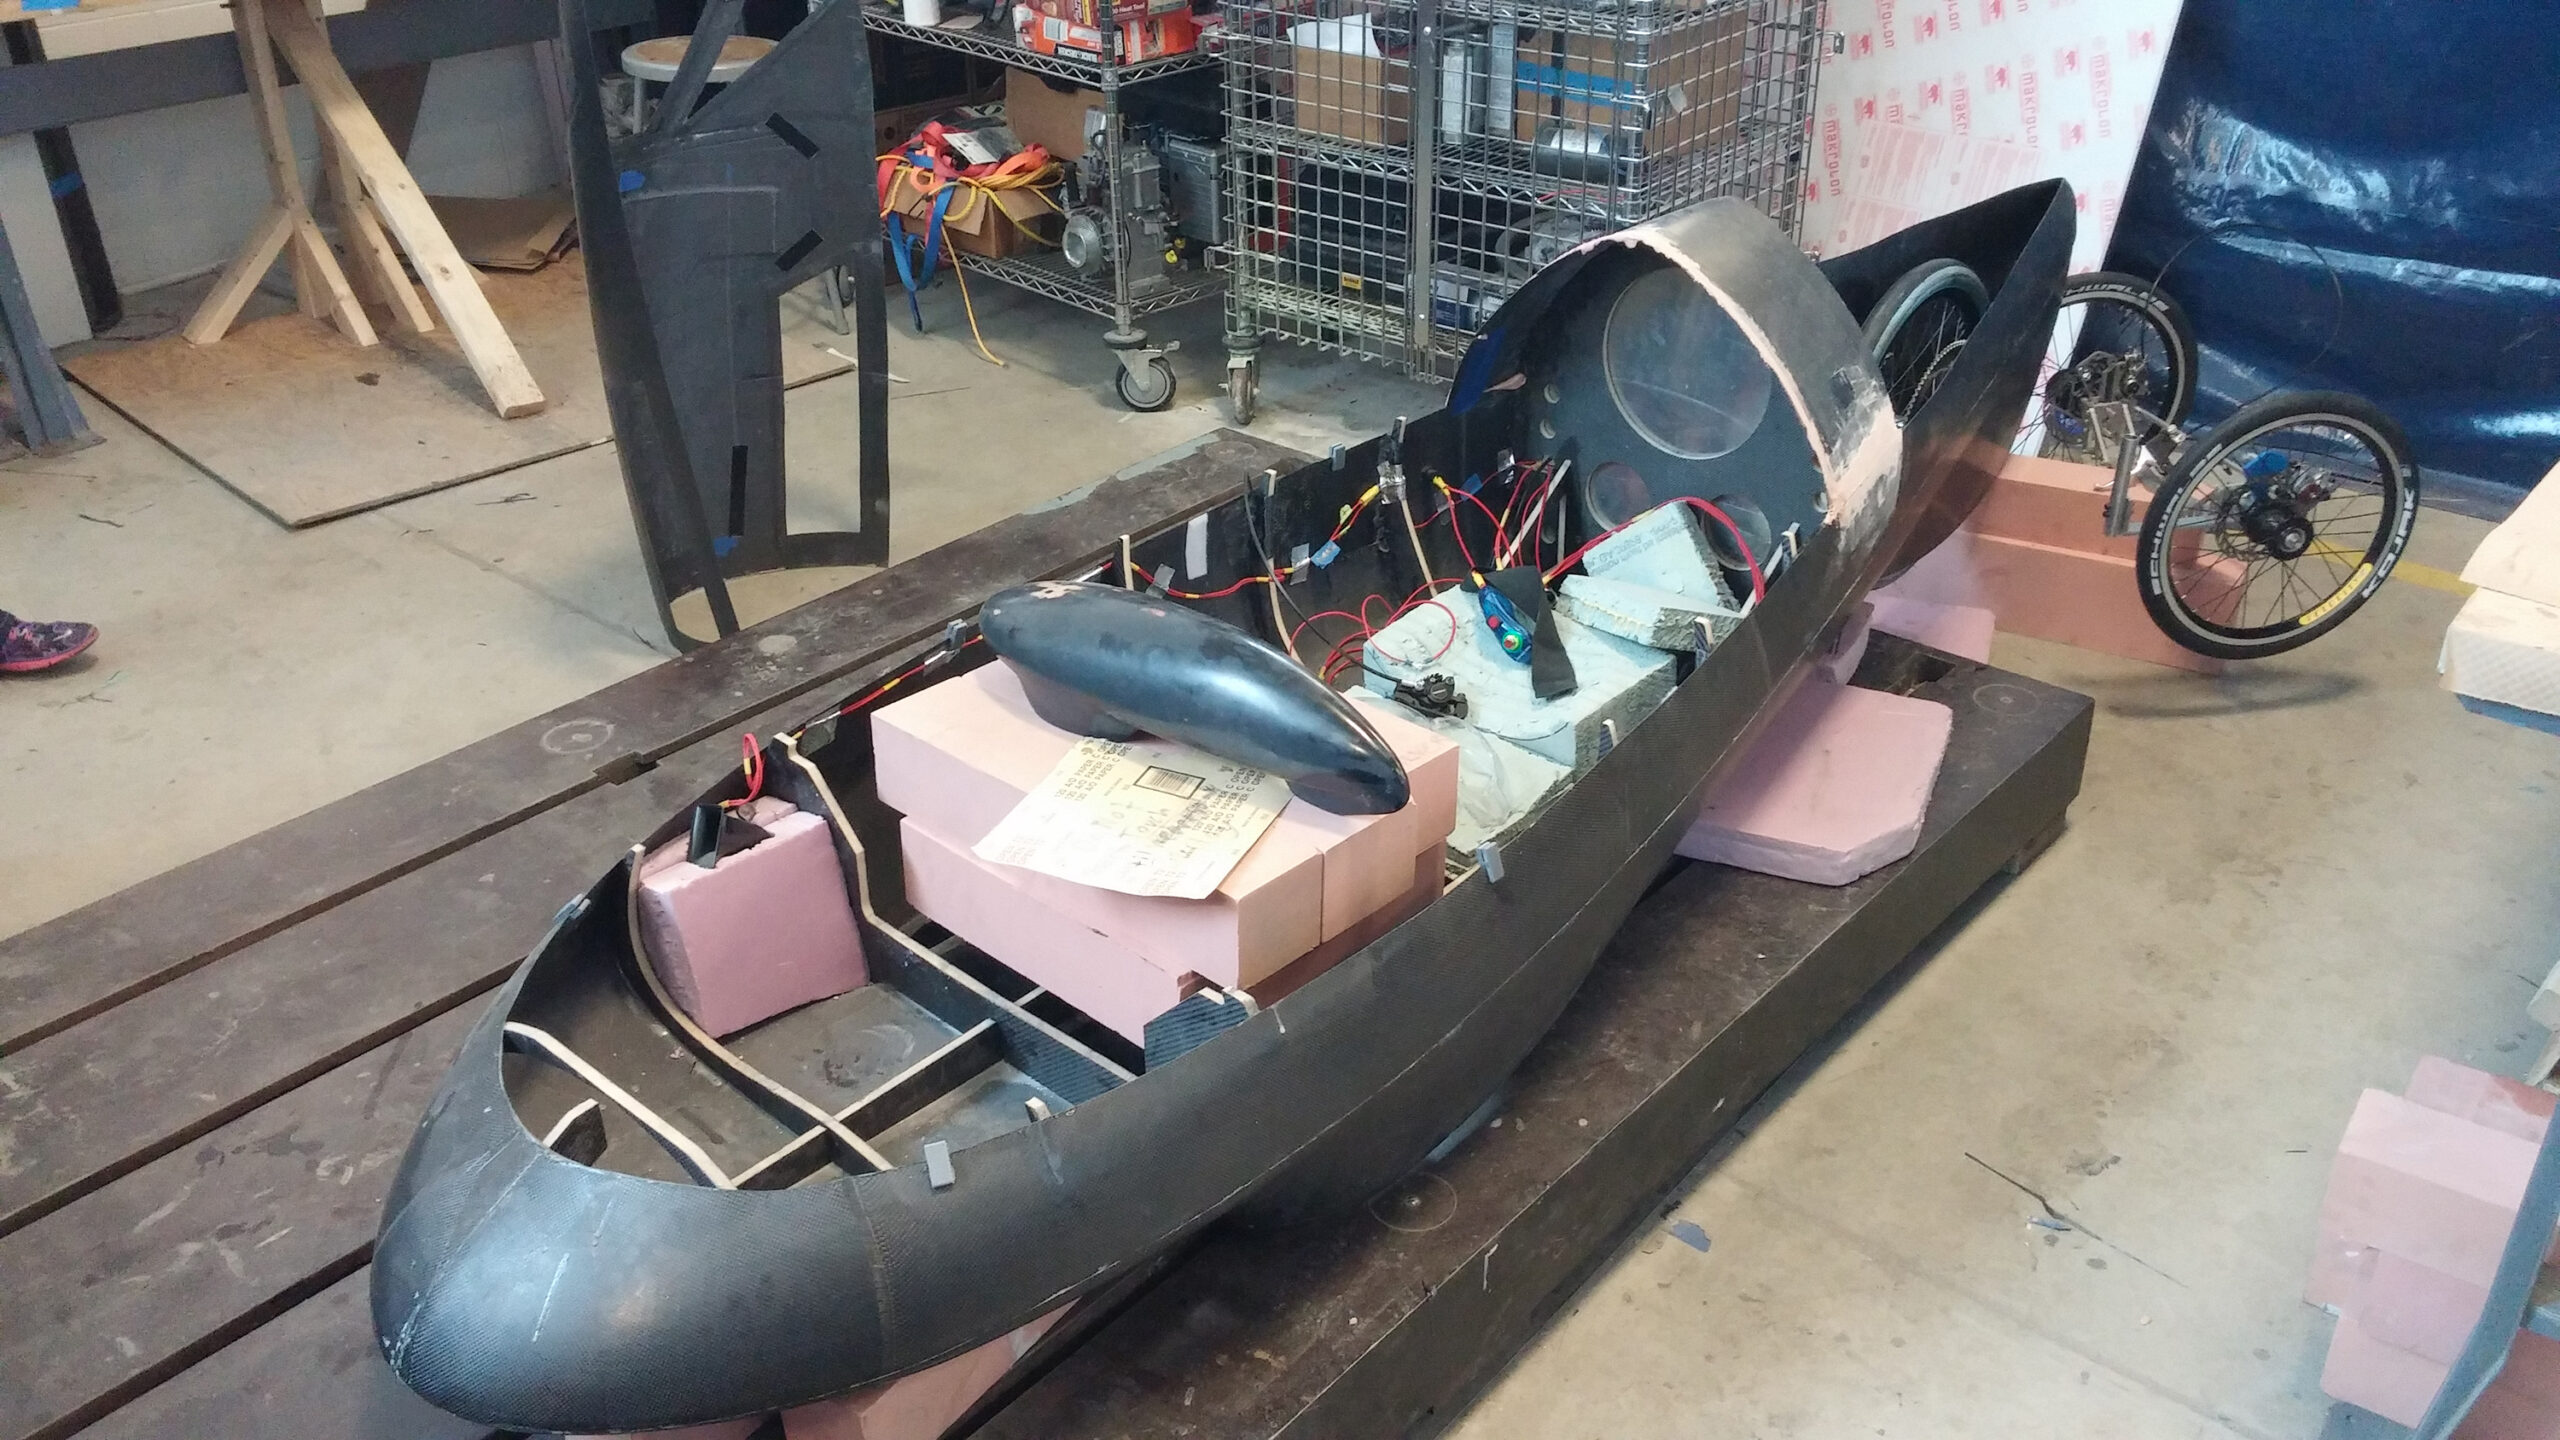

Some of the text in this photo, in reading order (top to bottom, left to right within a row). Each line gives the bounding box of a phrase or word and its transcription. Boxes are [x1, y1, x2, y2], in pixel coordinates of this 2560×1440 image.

[2093, 54, 2112, 138] makrolon
[1954, 88, 1969, 136] makr
[1824, 119, 1842, 197] makrolon
[2361, 487, 2416, 599] KOJAK
[1074, 760, 1094, 775] PAPER
[1084, 762, 1103, 777] PAPER
[1095, 764, 1114, 779] PAPER
[1210, 790, 1229, 808] PAPER
[1220, 792, 1239, 809] PAPER
[1231, 794, 1249, 811] PAPER
